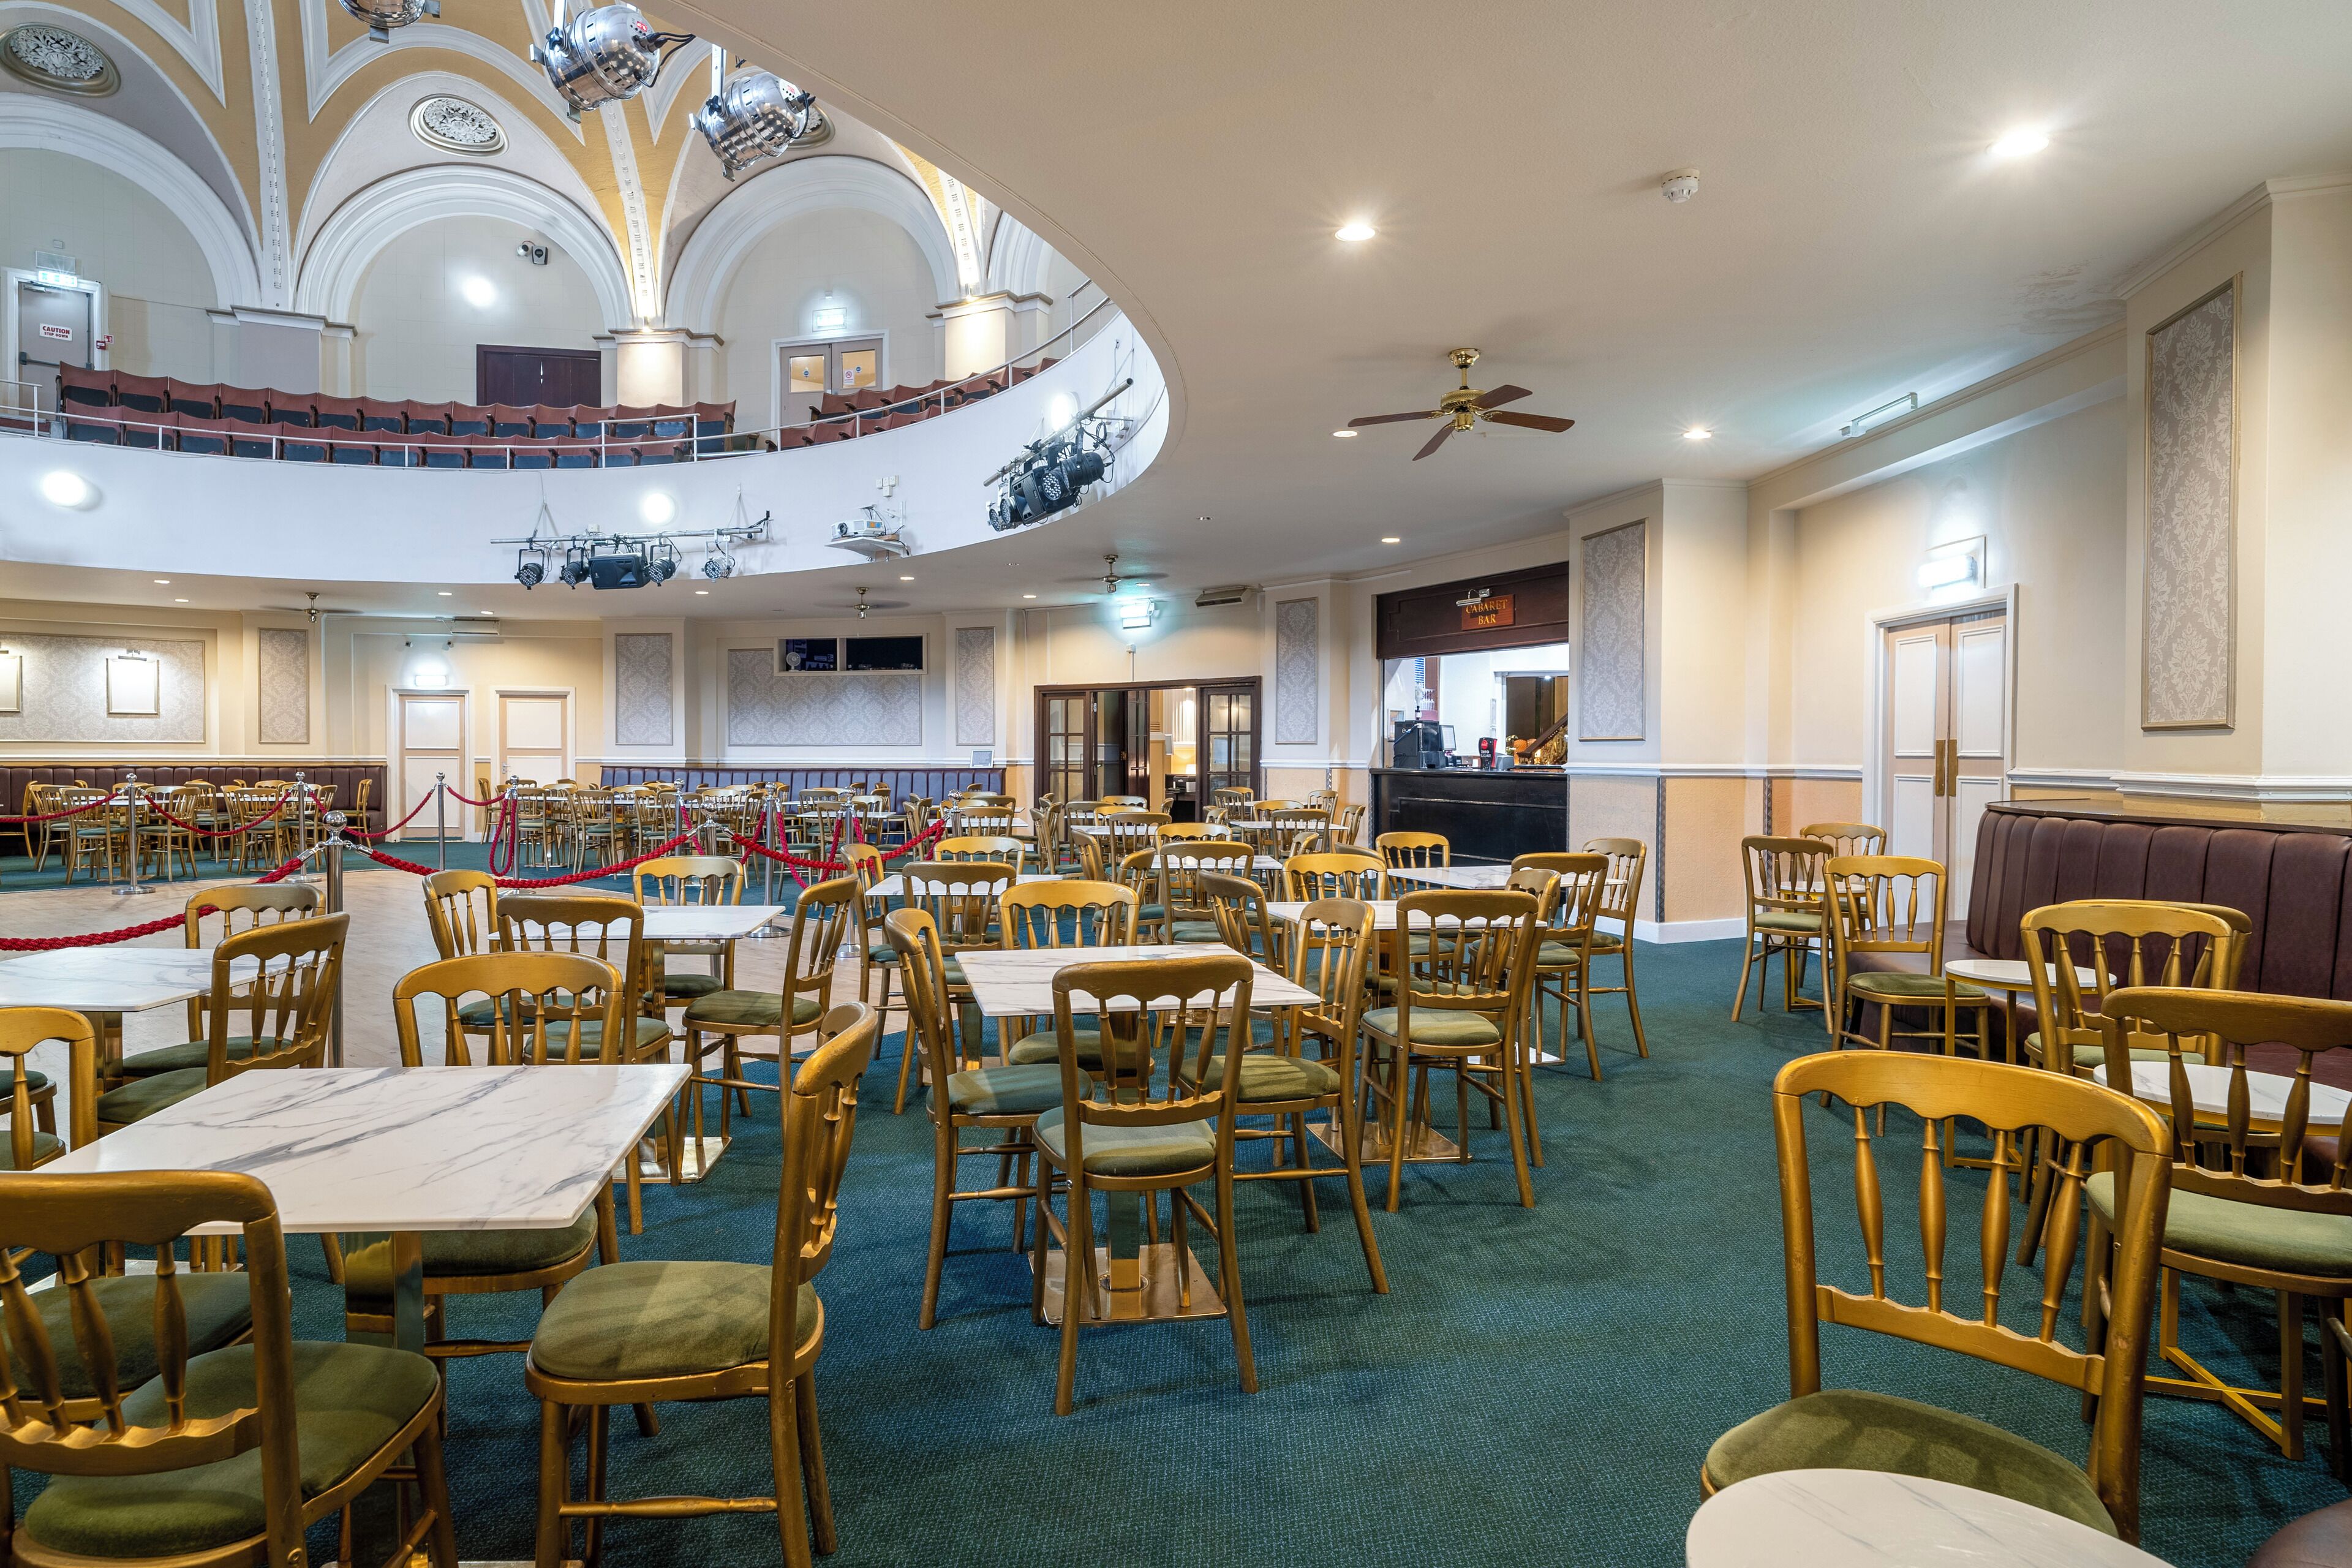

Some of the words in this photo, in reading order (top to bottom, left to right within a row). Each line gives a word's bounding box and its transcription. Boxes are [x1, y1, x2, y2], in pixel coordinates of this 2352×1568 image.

[42, 326, 70, 334] CAUTION
[1466, 600, 1507, 614] CABARET
[1478, 614, 1496, 625] BAR
